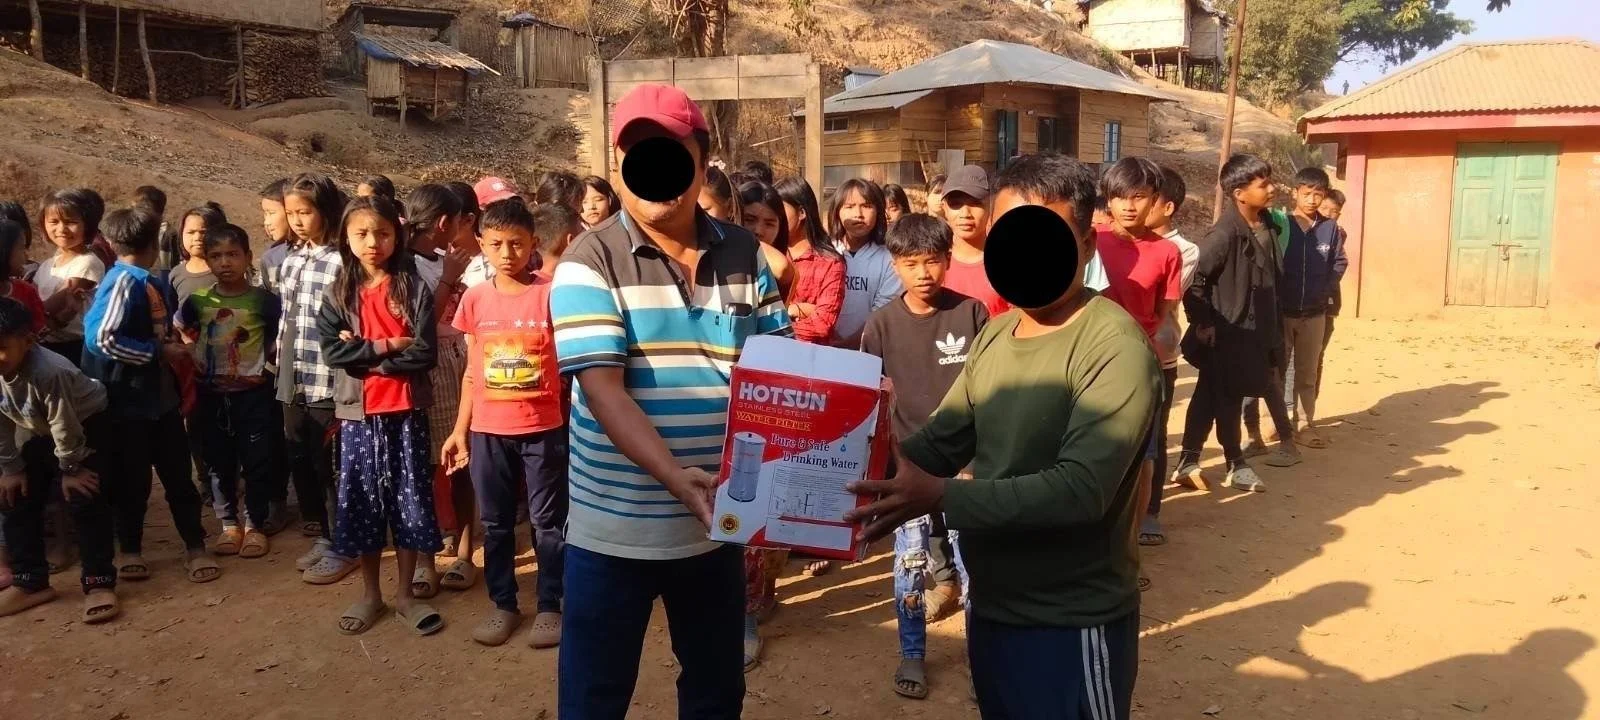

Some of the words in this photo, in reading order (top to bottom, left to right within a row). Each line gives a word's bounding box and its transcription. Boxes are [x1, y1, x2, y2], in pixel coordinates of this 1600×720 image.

[739, 381, 826, 412] HOTSUN
[737, 402, 783, 414] STAINLESS
[784, 409, 811, 419] STEEL
[736, 410, 770, 424] WATER
[775, 417, 812, 431] FILTER
[771, 433, 796, 448] Pure
[798, 438, 806, 449] &
[807, 439, 830, 452] Safe
[782, 450, 828, 469] Drinking
[831, 457, 858, 469] Water
